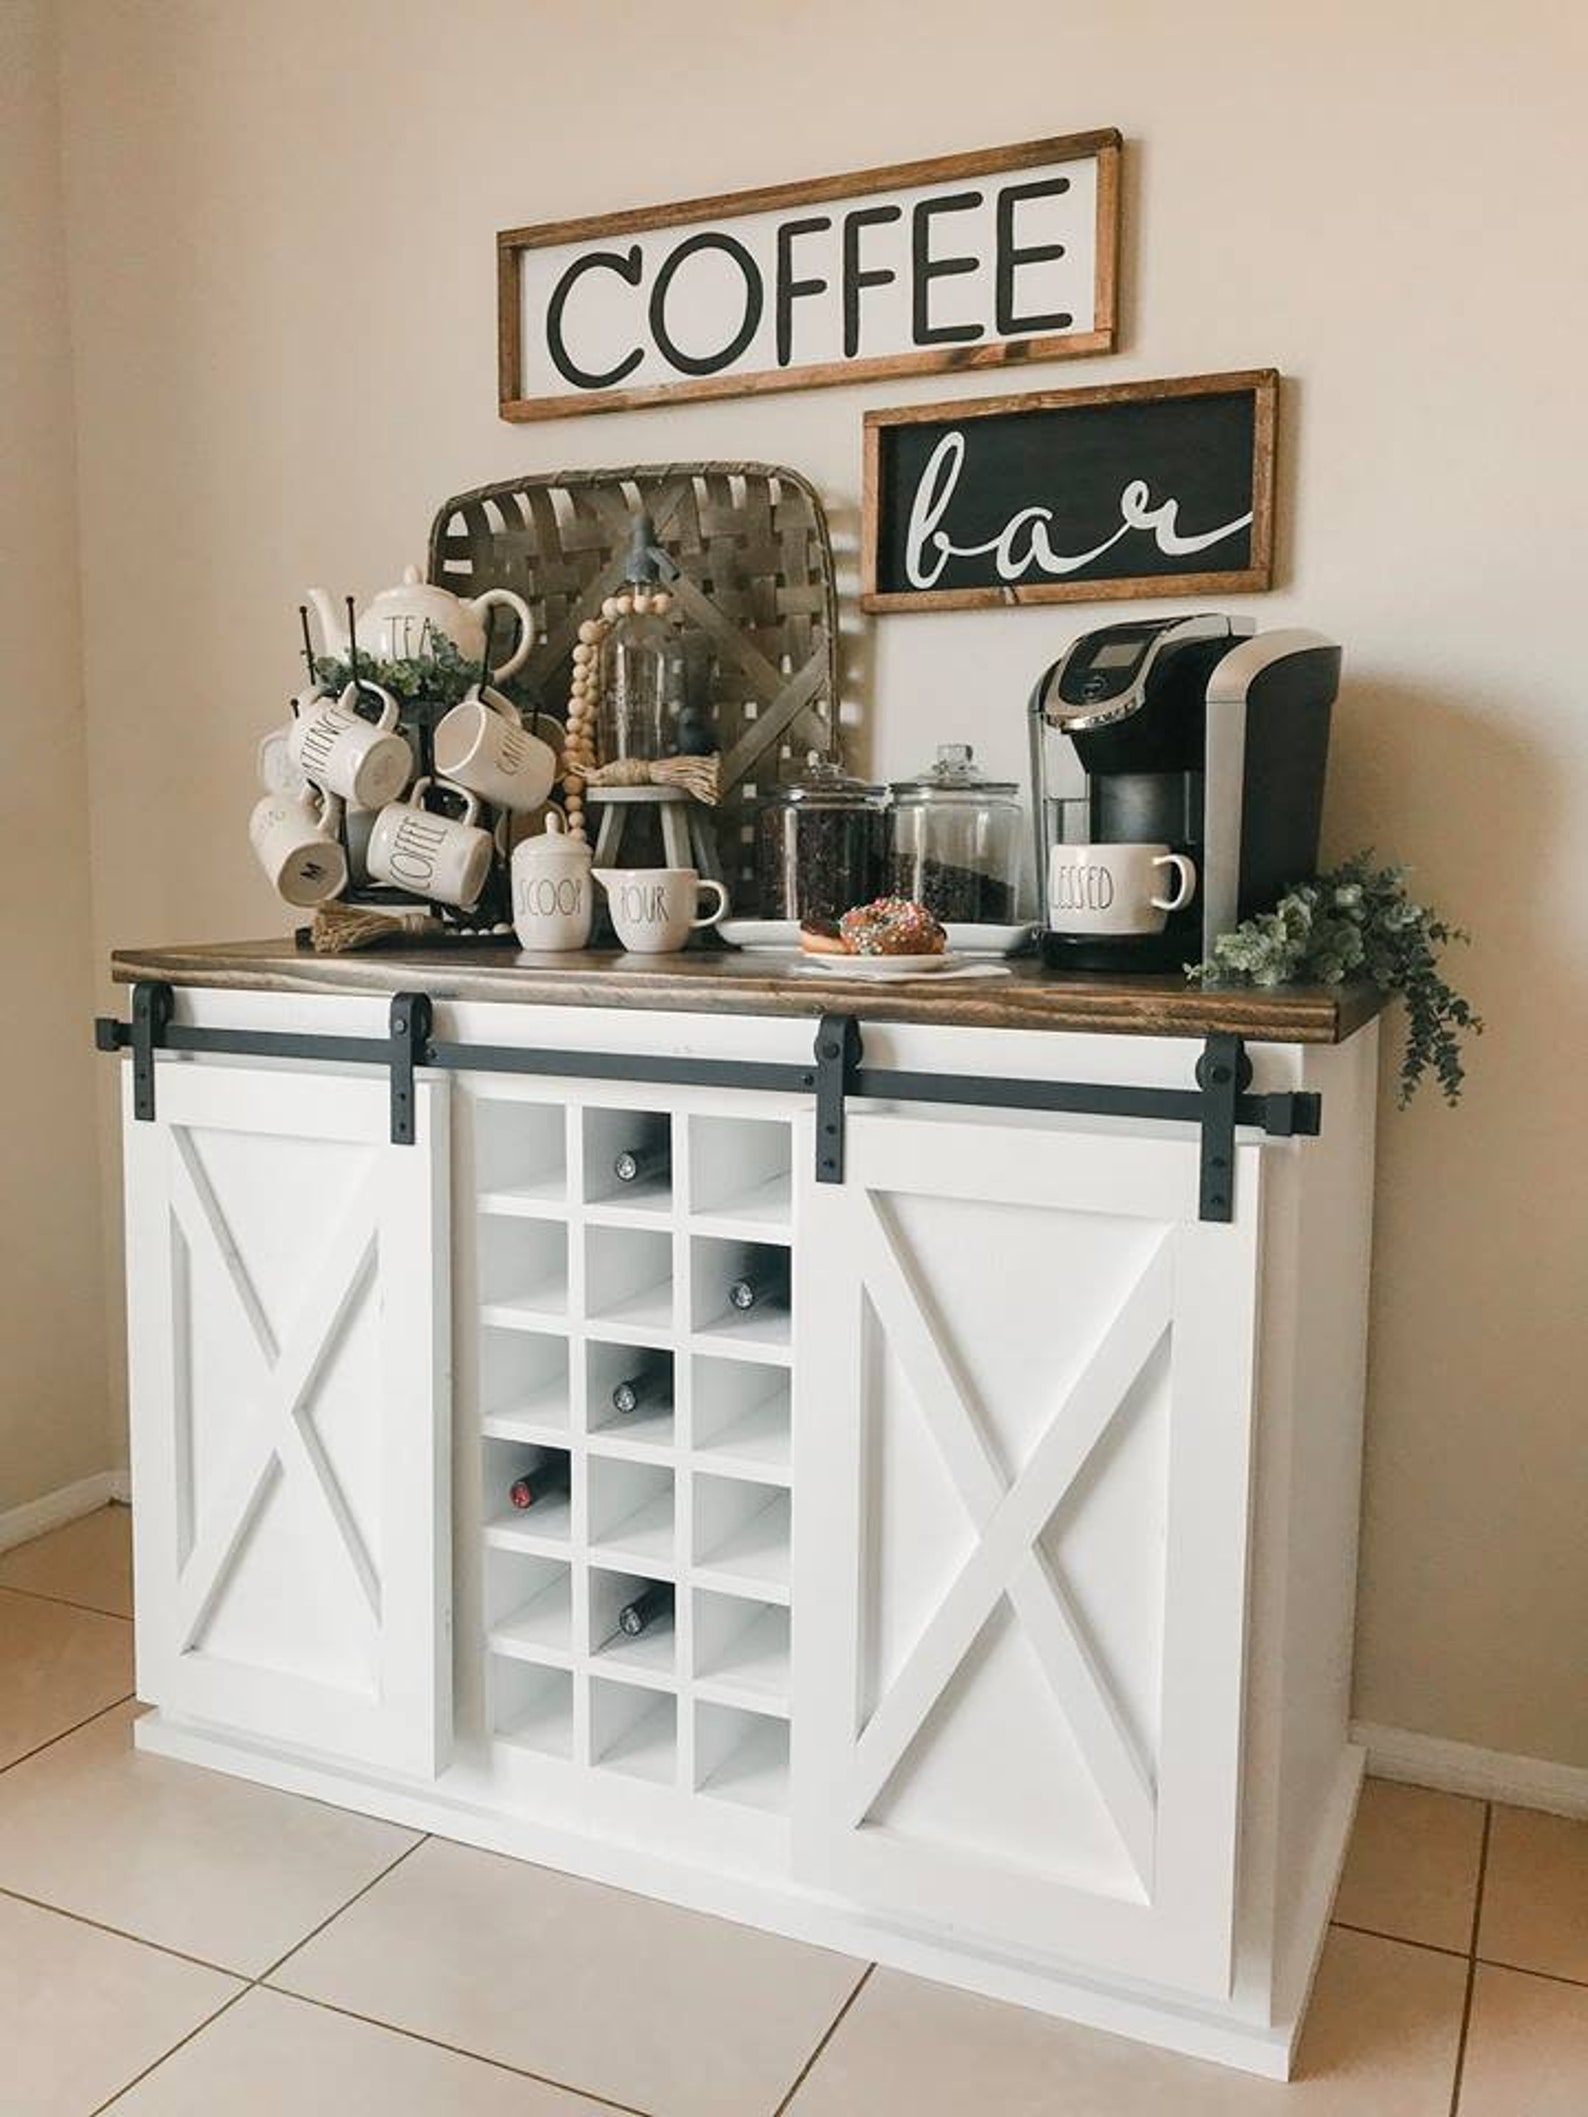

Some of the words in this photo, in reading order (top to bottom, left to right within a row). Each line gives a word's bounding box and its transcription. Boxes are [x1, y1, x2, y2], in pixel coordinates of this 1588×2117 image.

[546, 177, 1073, 389] COFFEE
[905, 431, 1253, 590] bar
[382, 614, 435, 661] TEA
[302, 706, 361, 782] ATIENCE
[389, 816, 448, 892] COFFEE
[1051, 865, 1115, 911] LESSED
